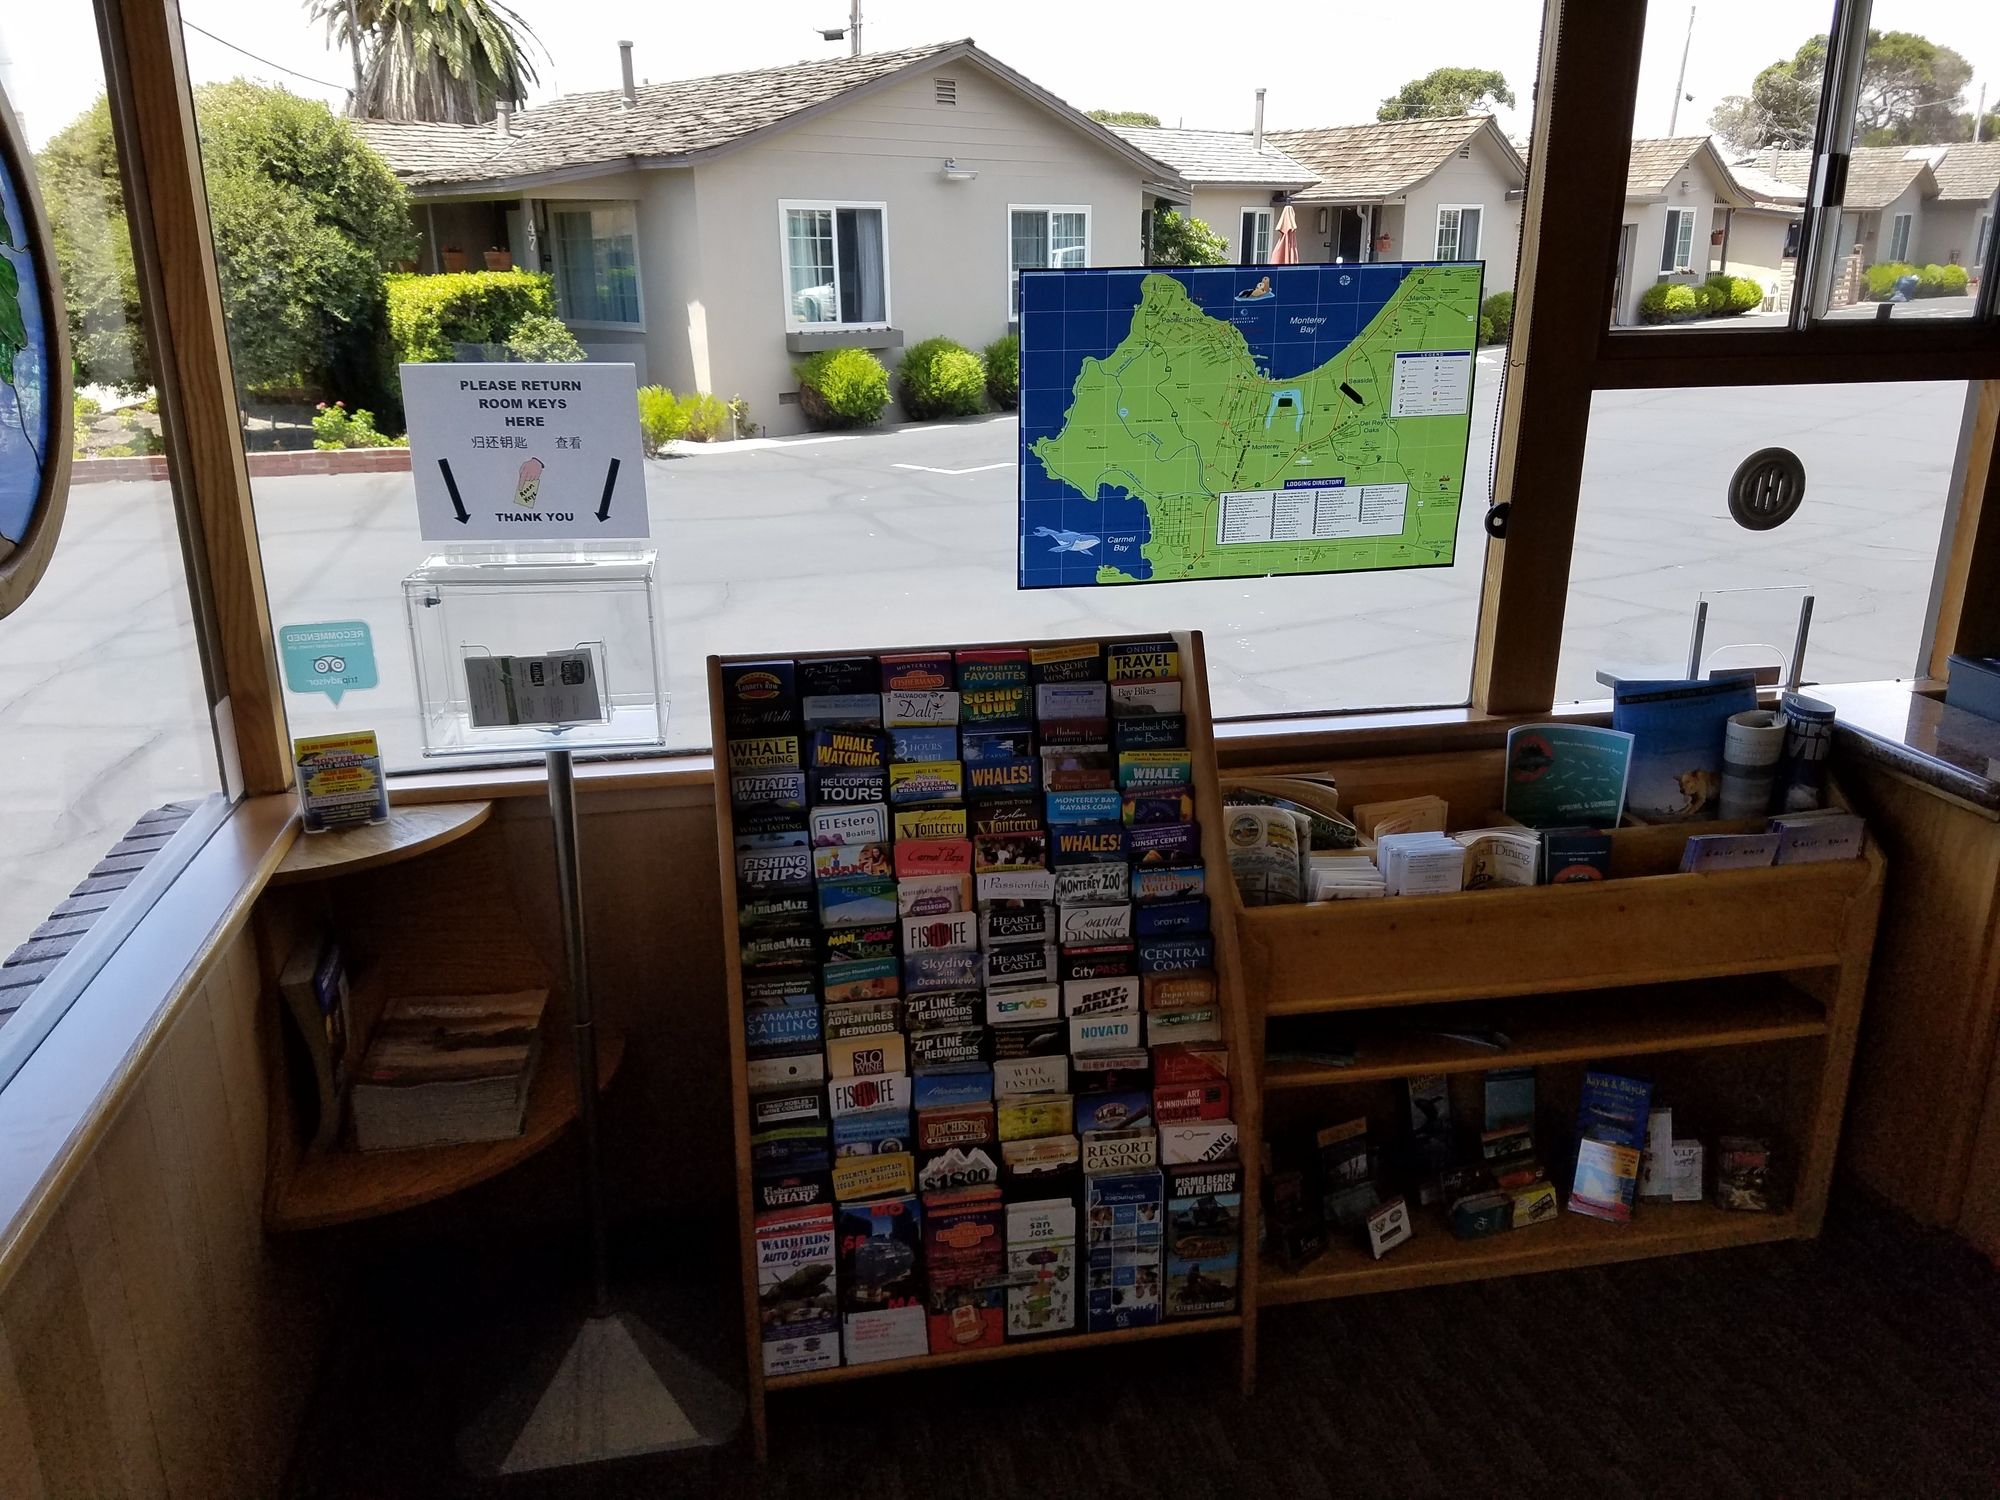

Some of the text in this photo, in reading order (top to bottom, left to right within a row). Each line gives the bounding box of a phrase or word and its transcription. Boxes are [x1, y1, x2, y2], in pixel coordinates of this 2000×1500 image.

[1161, 316, 1204, 324] Pacific Grove
[1289, 316, 1327, 326] Monterey
[1300, 325, 1316, 334] Bay
[460, 380, 582, 391] PLEASE RETURN
[478, 398, 567, 409] ROOM KEYS
[505, 416, 545, 427] HERE
[1371, 420, 1384, 428] Rey
[471, 436, 582, 450] 归还钥匙 查看
[1312, 478, 1343, 486] DIRECTORY
[495, 512, 575, 522] THANK YOU
[1107, 536, 1136, 544] Carmel
[1113, 544, 1129, 552] Bay
[1126, 645, 1161, 653] ONLINE
[896, 663, 938, 671] MONTEREY'S
[1043, 661, 1089, 673] PASSPORT
[1114, 655, 1171, 669] TRAVEL
[893, 675, 943, 687] FISHERMAN'S
[964, 671, 1026, 680] FAVORITES
[1116, 669, 1156, 680] INFO
[963, 688, 1023, 705] SCENIC
[1118, 687, 1157, 698] Bay Bikes
[970, 700, 1016, 715] TOUR
[759, 709, 791, 722] Walk
[1117, 720, 1180, 732] Horseback Ride
[832, 735, 874, 753] WHALE
[1145, 732, 1172, 743] Beach
[729, 741, 797, 757] WHALE
[910, 743, 943, 751] HOURS
[311, 755, 364, 764] MONTEREY
[735, 755, 794, 767] WATCHING
[816, 745, 881, 766] WATCHING
[971, 765, 1032, 787] WHALES!
[1133, 768, 1180, 779] WHALE
[737, 777, 798, 791] WHALE
[820, 777, 883, 786] HELICOPTER
[904, 780, 949, 788] MONTEREY
[738, 789, 799, 801] WATCHING
[820, 788, 883, 800] TOURS
[767, 823, 802, 831] TASTING
[819, 816, 875, 830] El Estero
[846, 829, 876, 838] Boating
[1061, 834, 1122, 853] WHALES!
[1131, 838, 1159, 848] SUNSET
[1159, 836, 1188, 844] CENTER
[1495, 844, 1530, 865] Dining
[744, 856, 807, 870] FISHING
[744, 867, 807, 883] TRIPS
[990, 877, 1050, 890] Passionfish
[1060, 873, 1120, 895] MONTEREY ZOO
[912, 902, 950, 912] CROSSROADS
[993, 915, 1037, 927] HEARST
[1065, 910, 1126, 931] Coastal
[1001, 922, 1043, 935] CASTLE
[1065, 928, 1126, 942] DINING
[827, 934, 855, 946] MINI
[864, 930, 894, 943] GOLF
[911, 922, 967, 949] FISHWIFE
[993, 952, 1037, 966] HEARST
[1144, 947, 1208, 960] CENTRAL
[852, 967, 874, 975] Museum
[922, 957, 973, 972] Skydive
[1001, 960, 1043, 973] CASTLE
[1153, 960, 1199, 972] COAST
[917, 976, 976, 986] Ocean views
[759, 988, 783, 996] Natural
[784, 986, 808, 995] History
[1081, 987, 1121, 1004] RENT
[909, 997, 956, 1013] ZIP LINE
[997, 997, 1048, 1013] tervis
[1072, 994, 1129, 1016] HARLEY
[747, 1009, 817, 1023] CATAMARAN
[828, 1011, 894, 1026] ADVENTURES
[918, 1006, 972, 1021] REDWOODS
[747, 1018, 818, 1035] SAILING
[839, 1023, 895, 1037] REDWOODS
[1081, 1024, 1129, 1039] NOVATO
[801, 1033, 818, 1042] BAY
[915, 1036, 963, 1051] ZIP LINE
[854, 1050, 882, 1066] SLO
[924, 1046, 979, 1060] REDWOODS
[854, 1062, 882, 1073] WINE
[1013, 1067, 1046, 1077] WINE
[1004, 1077, 1056, 1089] TASTING
[1586, 1074, 1609, 1090] Kayak
[835, 1079, 895, 1111] FISHWIFE
[1187, 1089, 1201, 1098] ART
[765, 1099, 809, 1109] PASO ROBLES
[782, 1104, 813, 1112] COUNTRY
[1157, 1098, 1201, 1109] & INNOVATION
[928, 1119, 986, 1136] WINCHESTER
[1088, 1141, 1153, 1158] RESORT
[1088, 1152, 1152, 1169] CASINO
[837, 1163, 902, 1181] YOSEMITE MOUNTAIN
[836, 1170, 908, 1191] SUGAR PINE RAILROAD
[1175, 1173, 1236, 1188] PISMO BEACH
[763, 1184, 819, 1196] Fisherman's
[1177, 1183, 1233, 1197] ATV RENTALS
[764, 1191, 819, 1206] WHARF
[1029, 1220, 1051, 1229] san
[761, 1233, 830, 1251] WARBIRDS
[762, 1245, 830, 1264] AUTO DISPLAY
